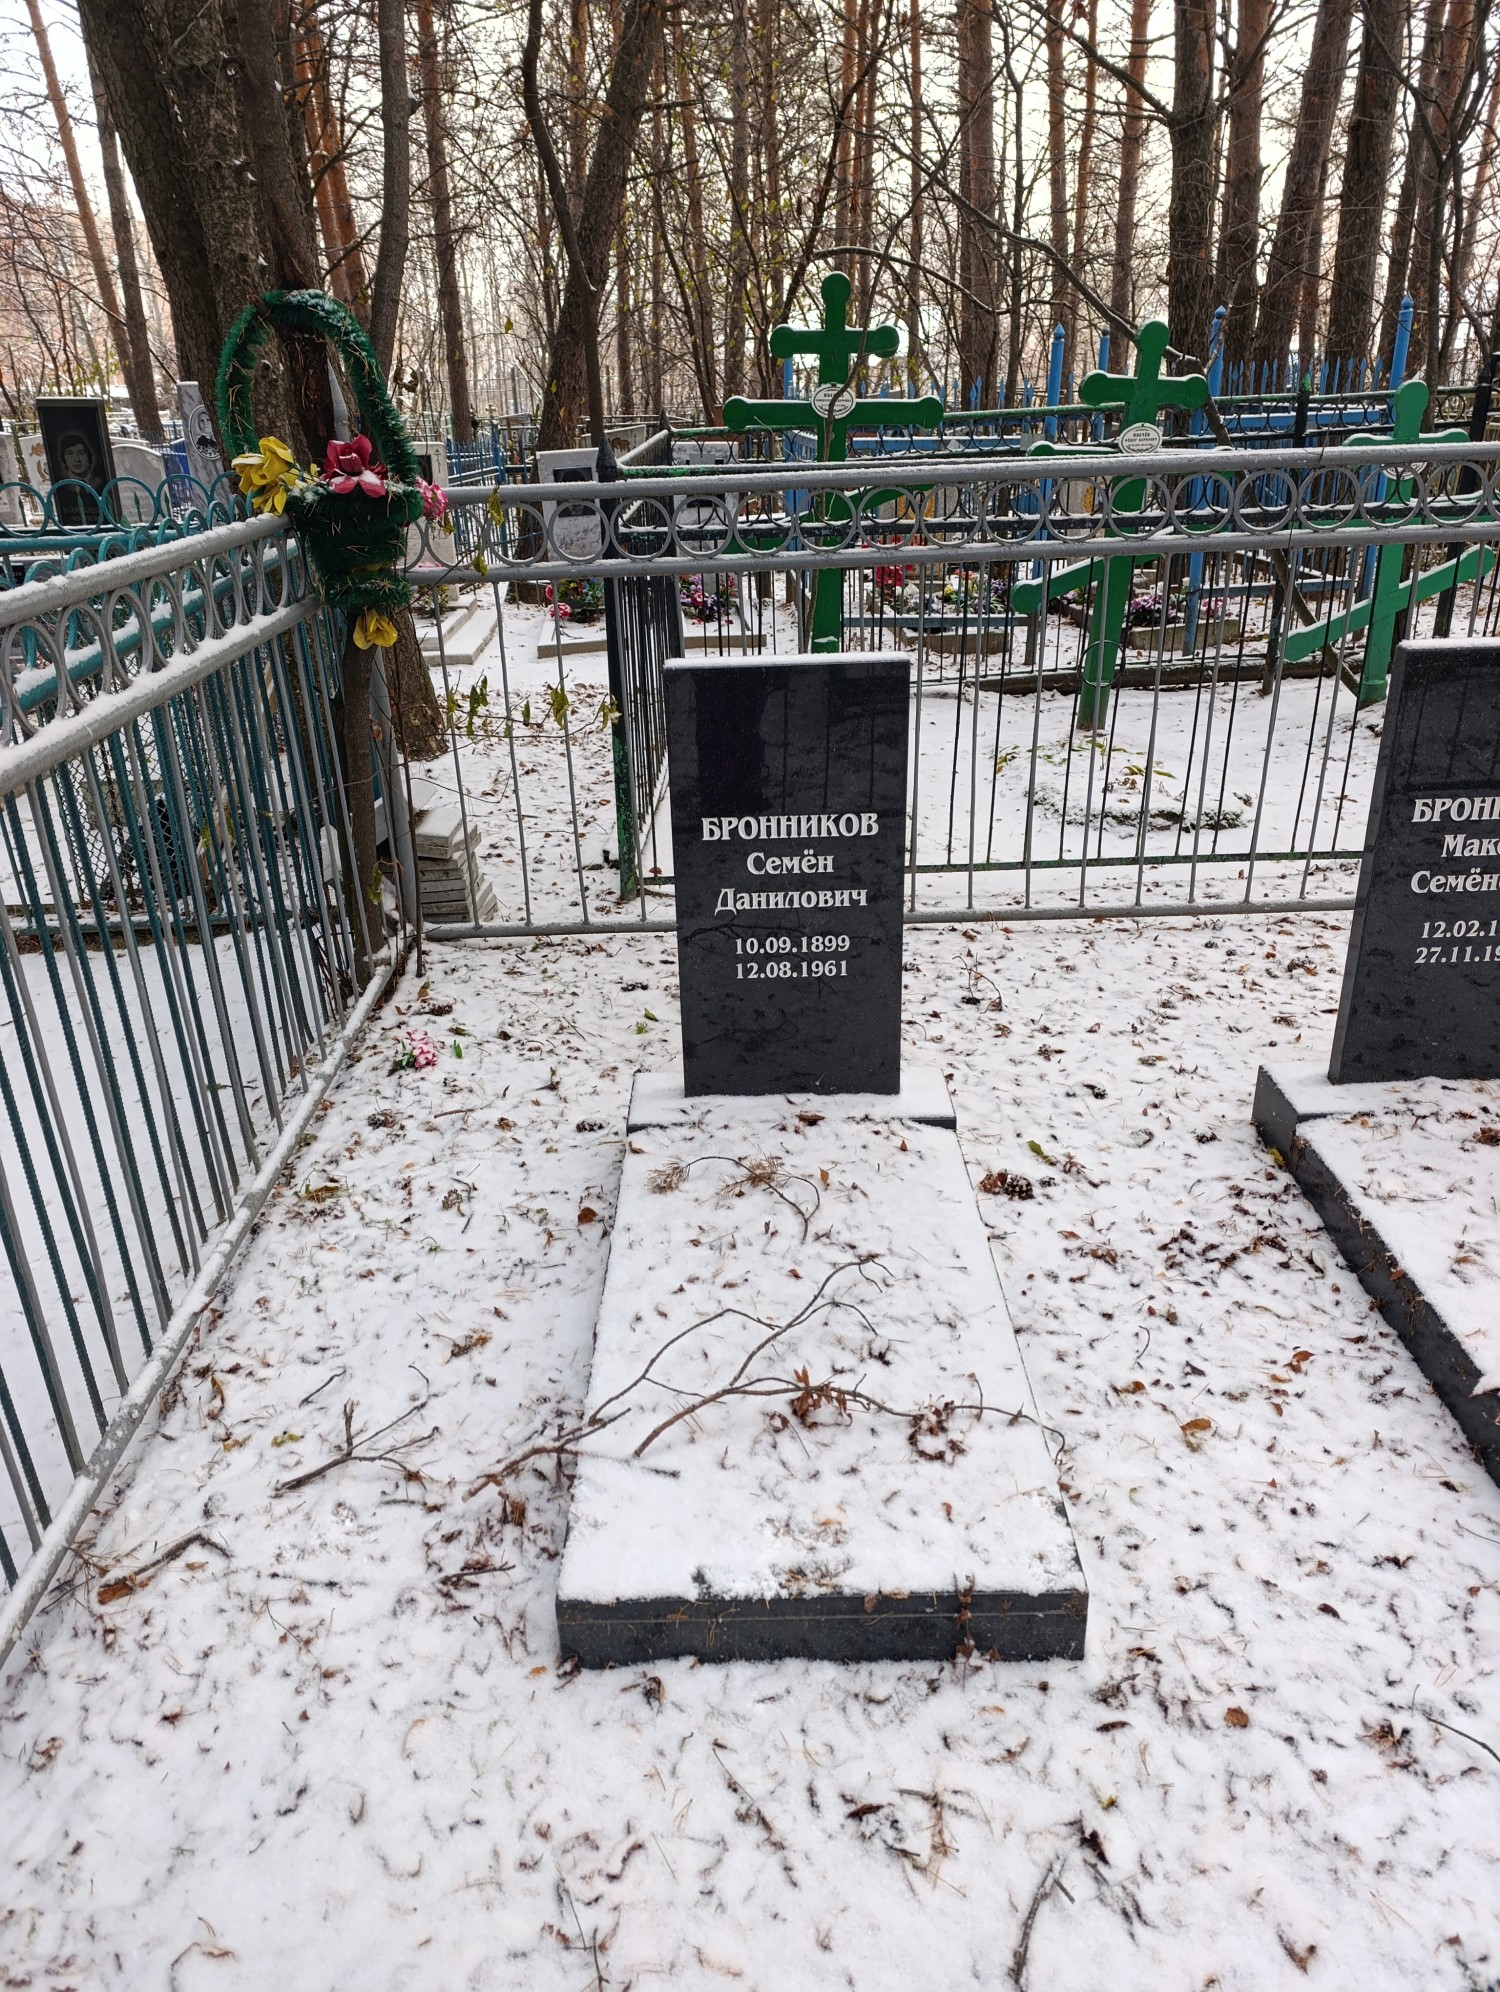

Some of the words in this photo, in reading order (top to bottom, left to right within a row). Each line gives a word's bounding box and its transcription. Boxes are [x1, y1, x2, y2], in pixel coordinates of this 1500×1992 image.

[701, 812, 880, 841] БРОННИКОВ
[1441, 834, 1500, 857] Мак
[746, 848, 835, 875] Семён
[1411, 867, 1500, 893] Семён
[714, 887, 868, 916] Данилович
[735, 934, 851, 955] 10.09.1899
[735, 959, 848, 979] 12.08.1961
